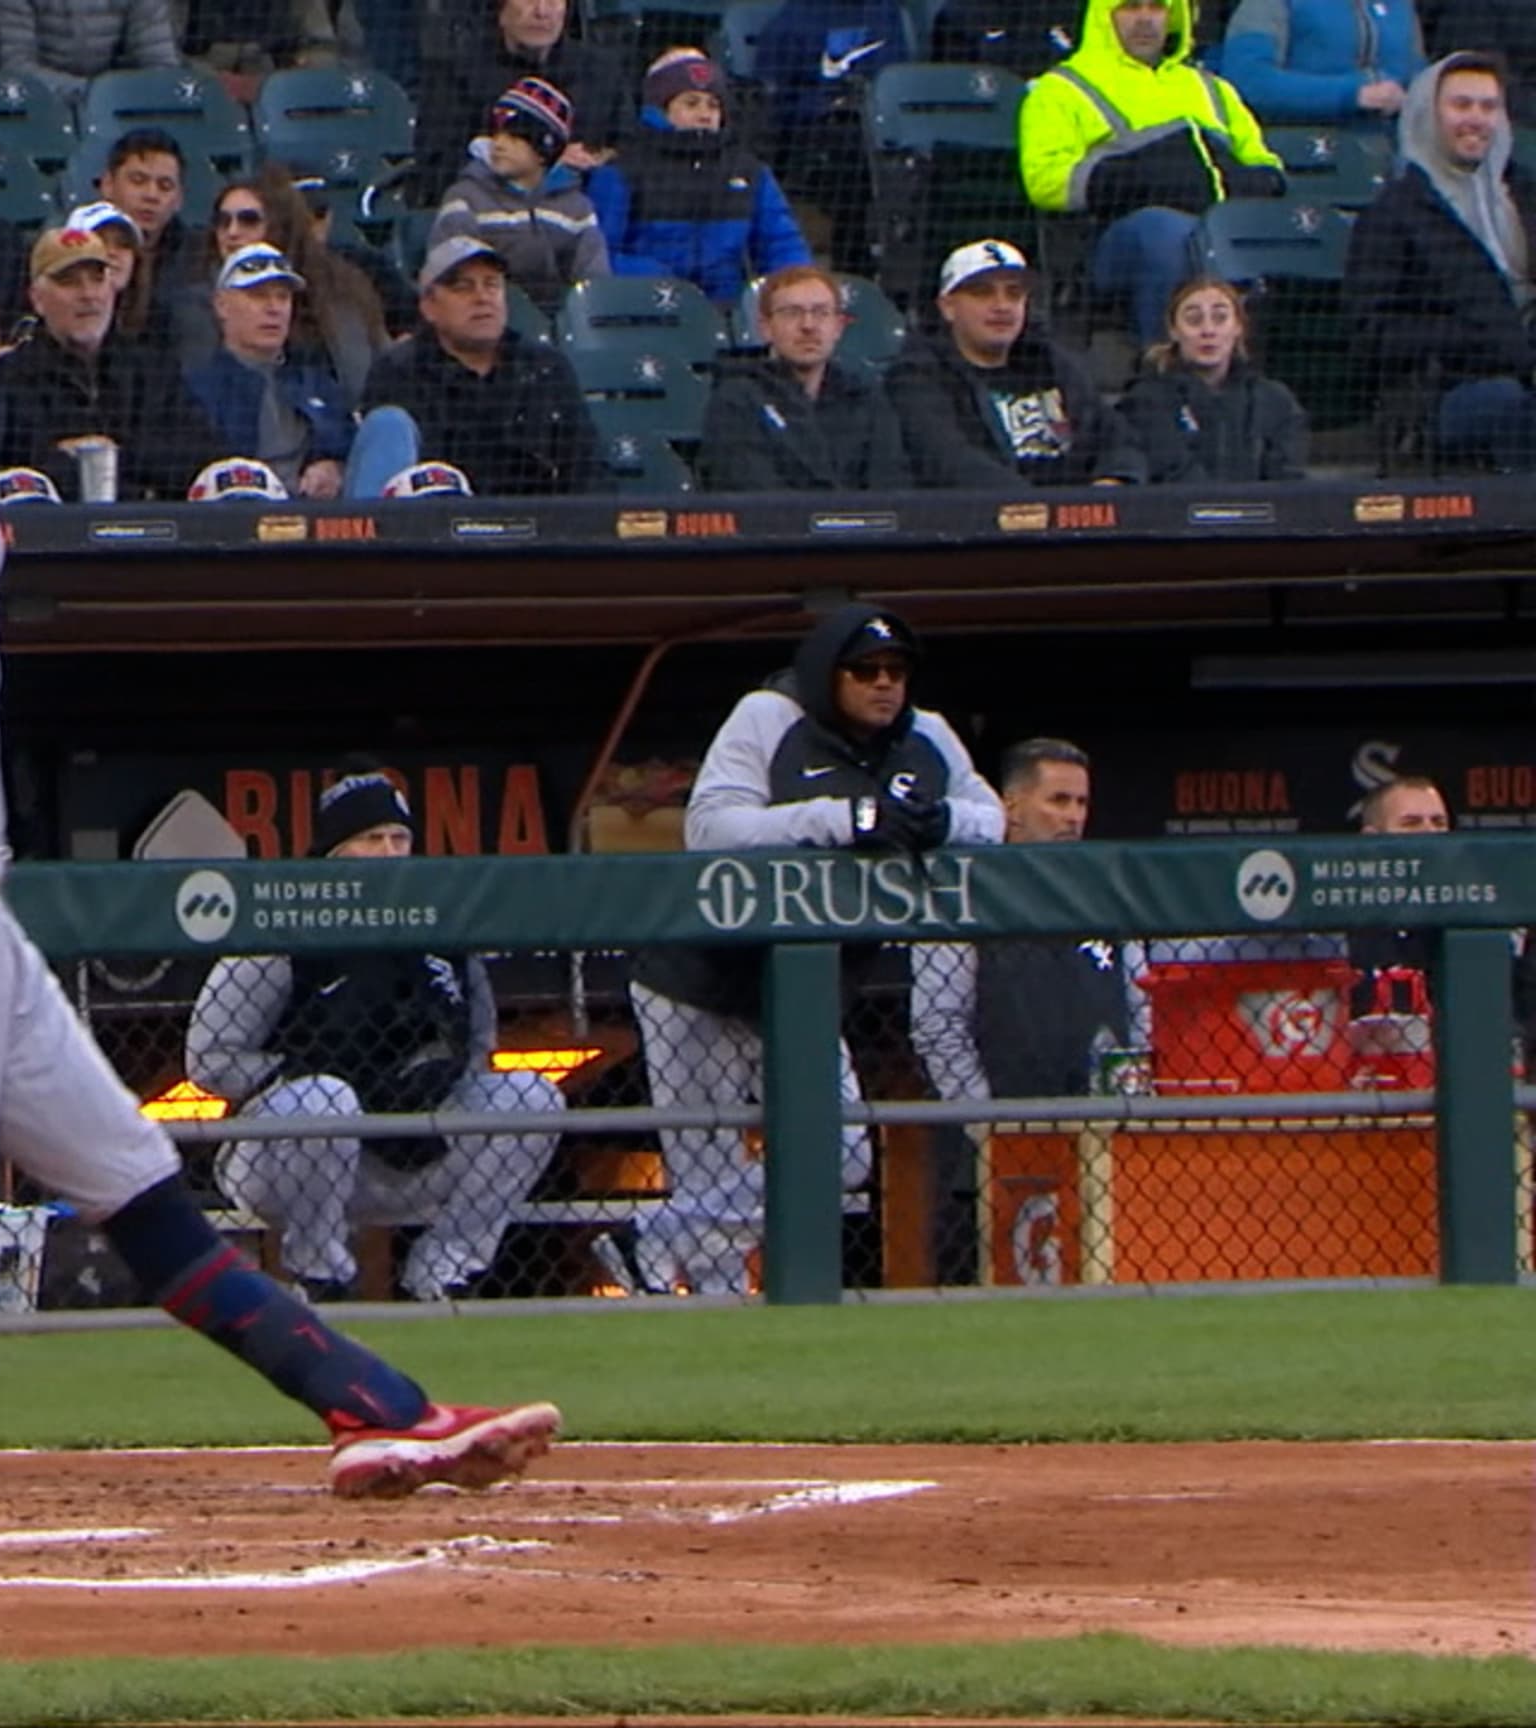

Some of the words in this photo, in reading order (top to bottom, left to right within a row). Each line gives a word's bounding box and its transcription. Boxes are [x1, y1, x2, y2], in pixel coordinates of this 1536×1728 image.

[1175, 772, 1289, 812] BUONA
[1467, 766, 1536, 807] BUO
[1312, 859, 1422, 878] MIDWEST
[253, 881, 364, 899] MIDWEST
[768, 856, 976, 927] RUSH
[1312, 884, 1497, 906] ORTHOPAEDICS
[254, 906, 439, 929] ORTHOPAEDICS
